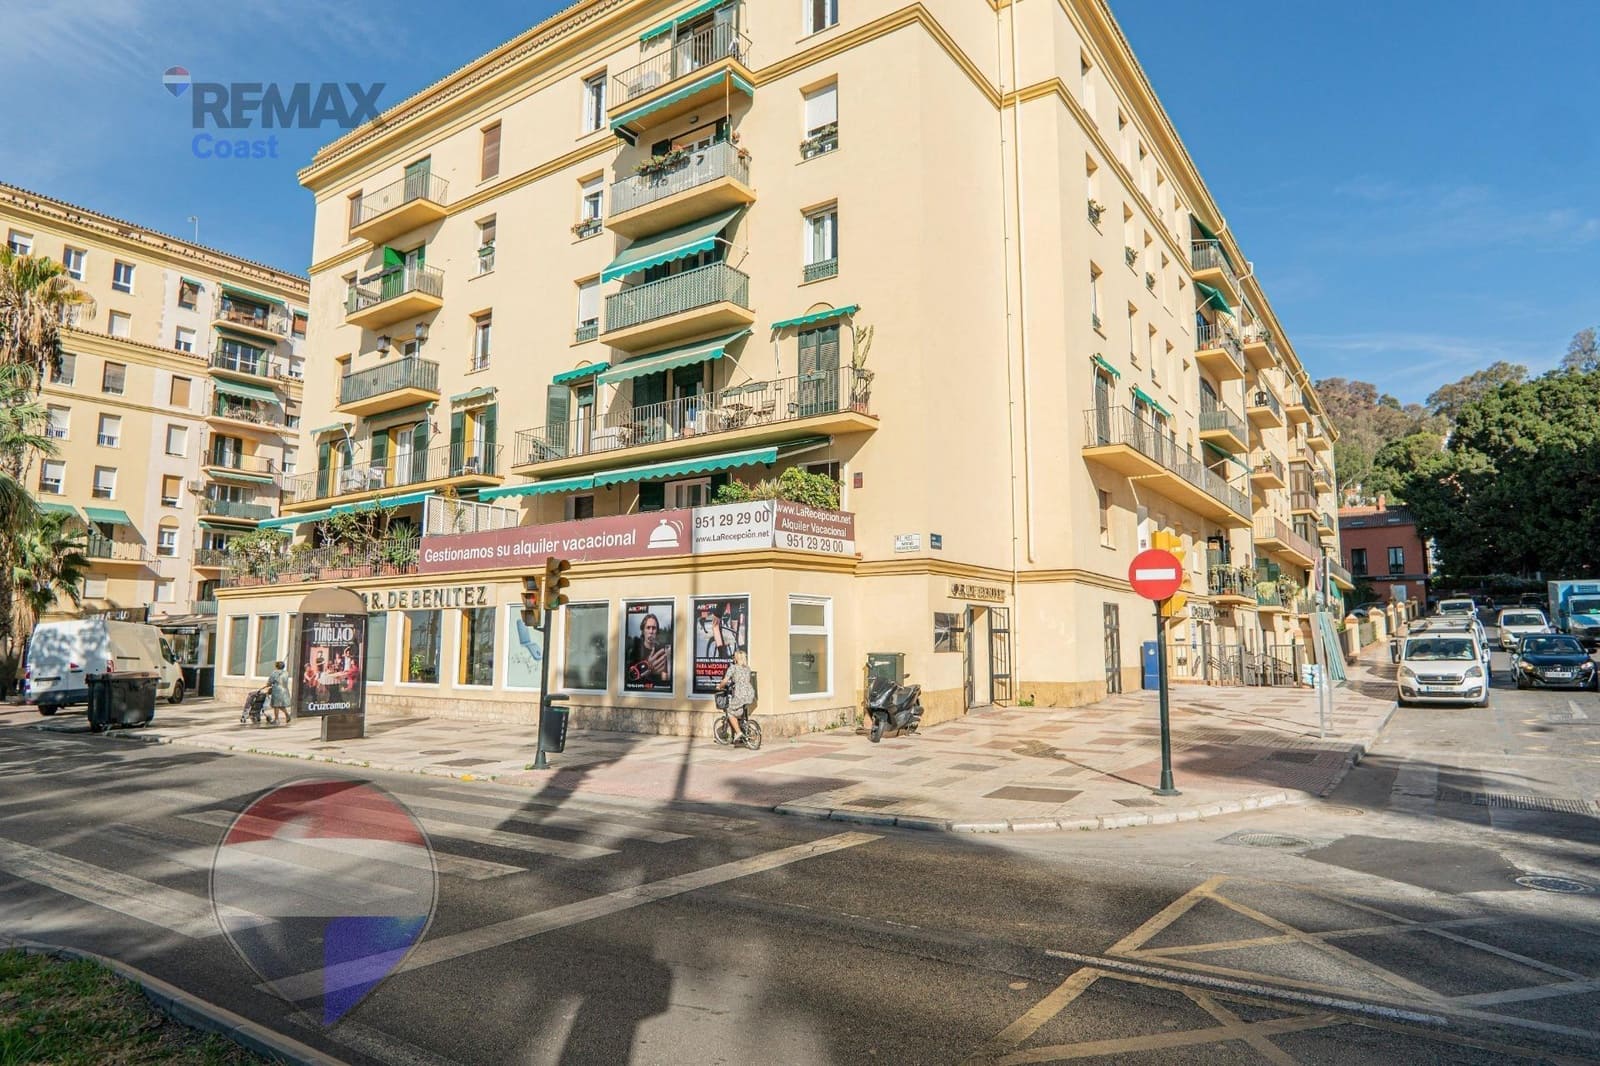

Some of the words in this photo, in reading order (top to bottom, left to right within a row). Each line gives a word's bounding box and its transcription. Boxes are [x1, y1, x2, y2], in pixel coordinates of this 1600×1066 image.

[695, 515, 715, 529] 951
[719, 513, 734, 527] 29
[736, 511, 751, 525] 29
[754, 509, 769, 524] 00
[777, 503, 852, 525] www.LaRecepcion.net
[695, 530, 769, 544] www.LaRecepcion.net
[781, 517, 810, 533] Alquiler
[810, 522, 847, 537] Vacacional
[424, 548, 494, 563] Gestionamos
[497, 544, 512, 557] su
[513, 539, 560, 558] alquiler
[562, 530, 636, 552] vacacional
[786, 533, 804, 549] 951
[806, 536, 818, 550] 29
[820, 538, 831, 552] 29
[832, 540, 844, 553] 00
[387, 590, 409, 608] DE
[411, 586, 487, 608] BENITEZ
[308, 702, 351, 711] Cruzcampo
